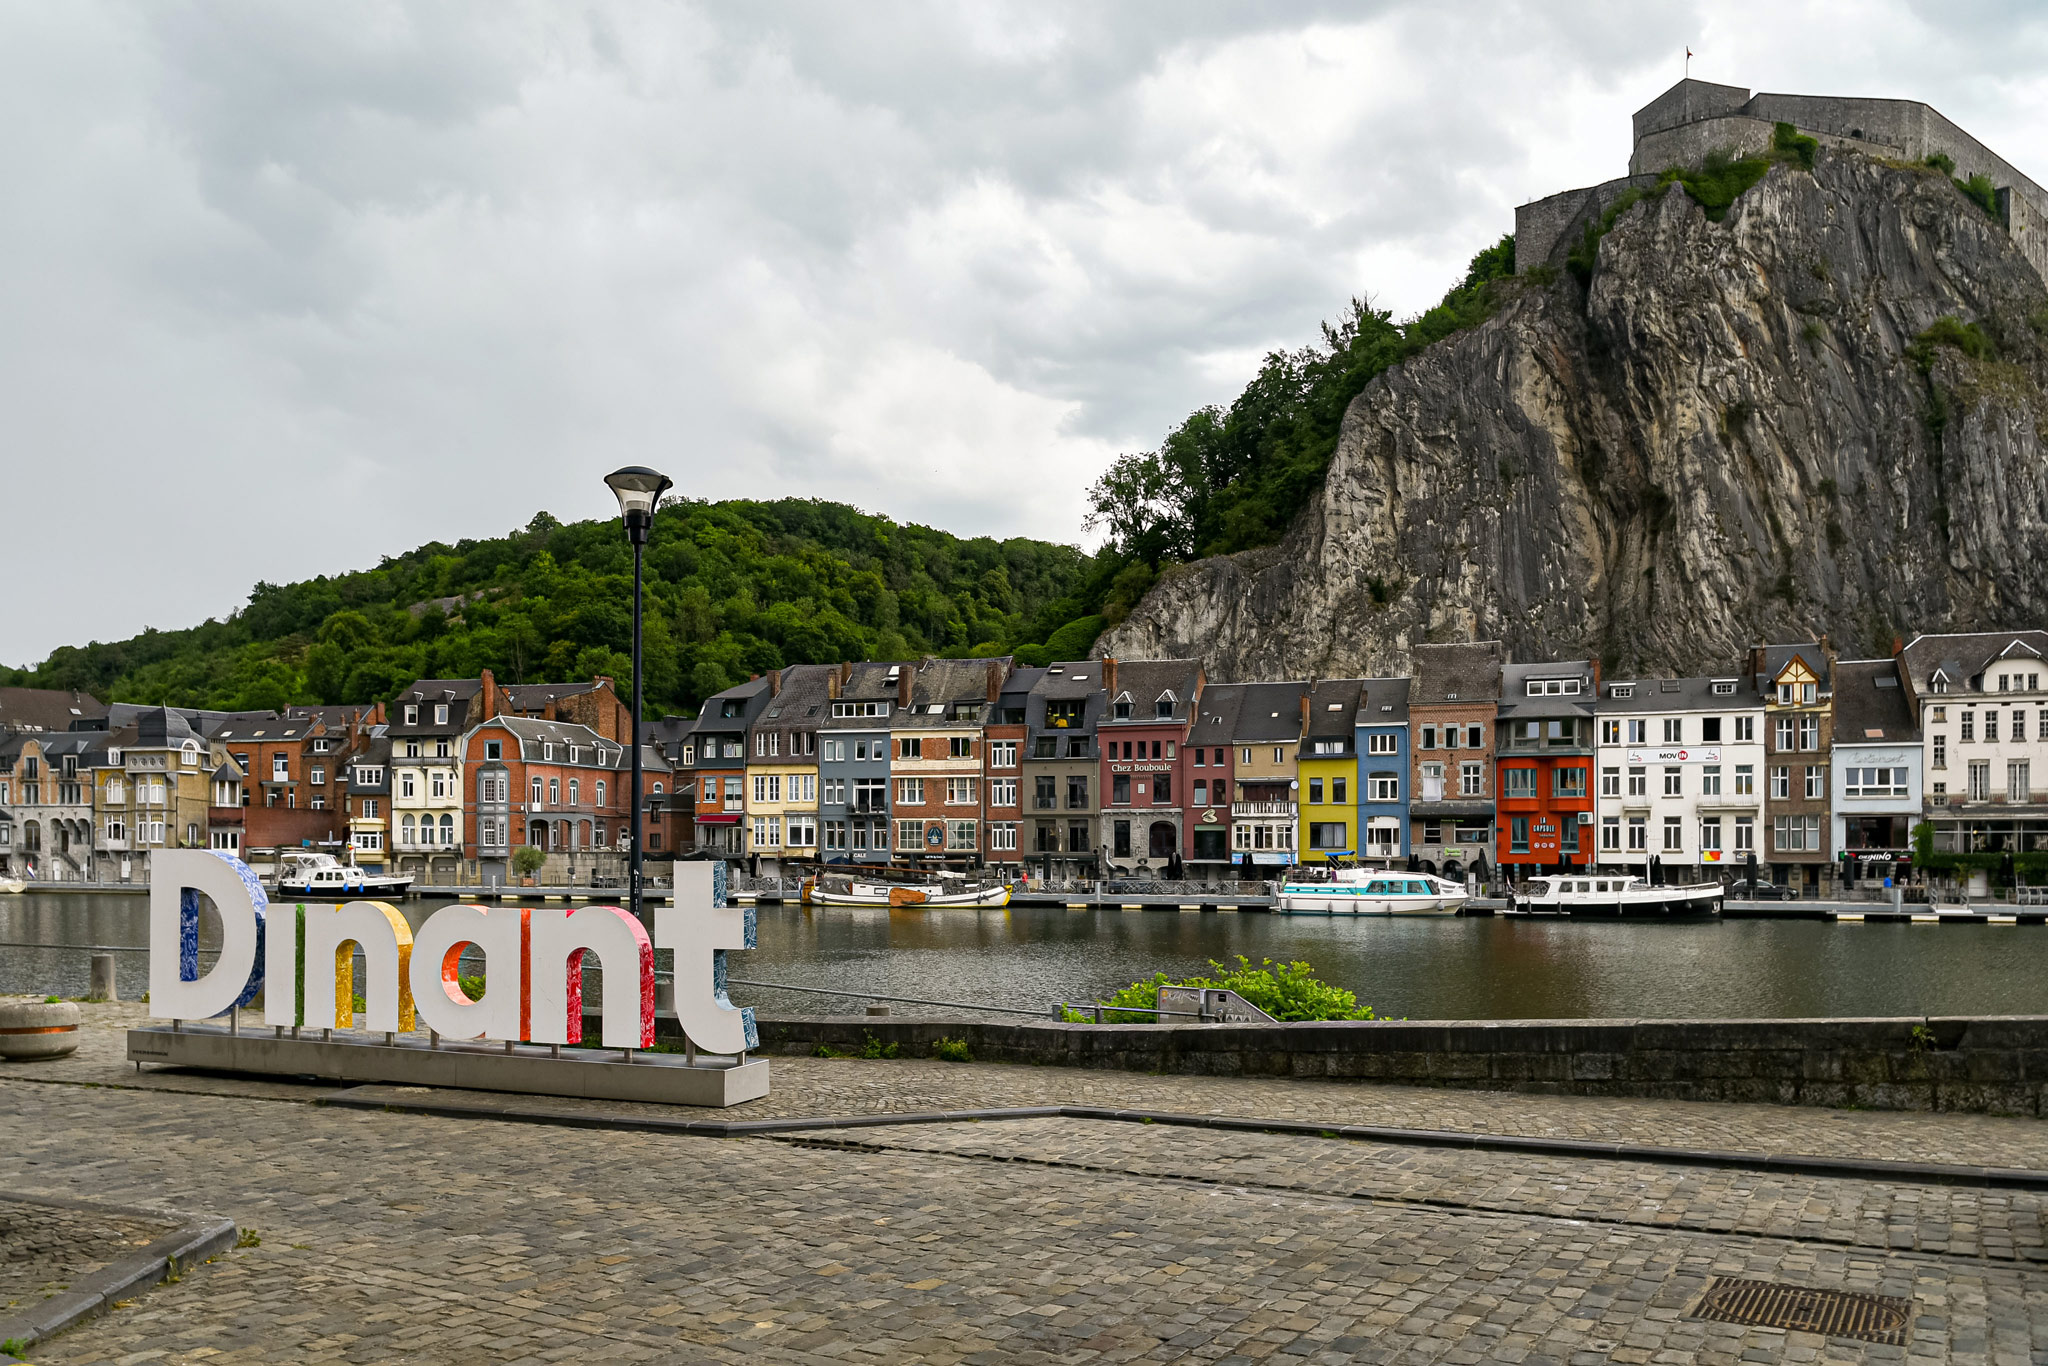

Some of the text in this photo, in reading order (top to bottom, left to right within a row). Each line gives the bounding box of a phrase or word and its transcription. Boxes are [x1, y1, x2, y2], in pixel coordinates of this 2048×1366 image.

[1111, 763, 1172, 772] Chez Bouboule
[149, 847, 758, 1055] Dinant
